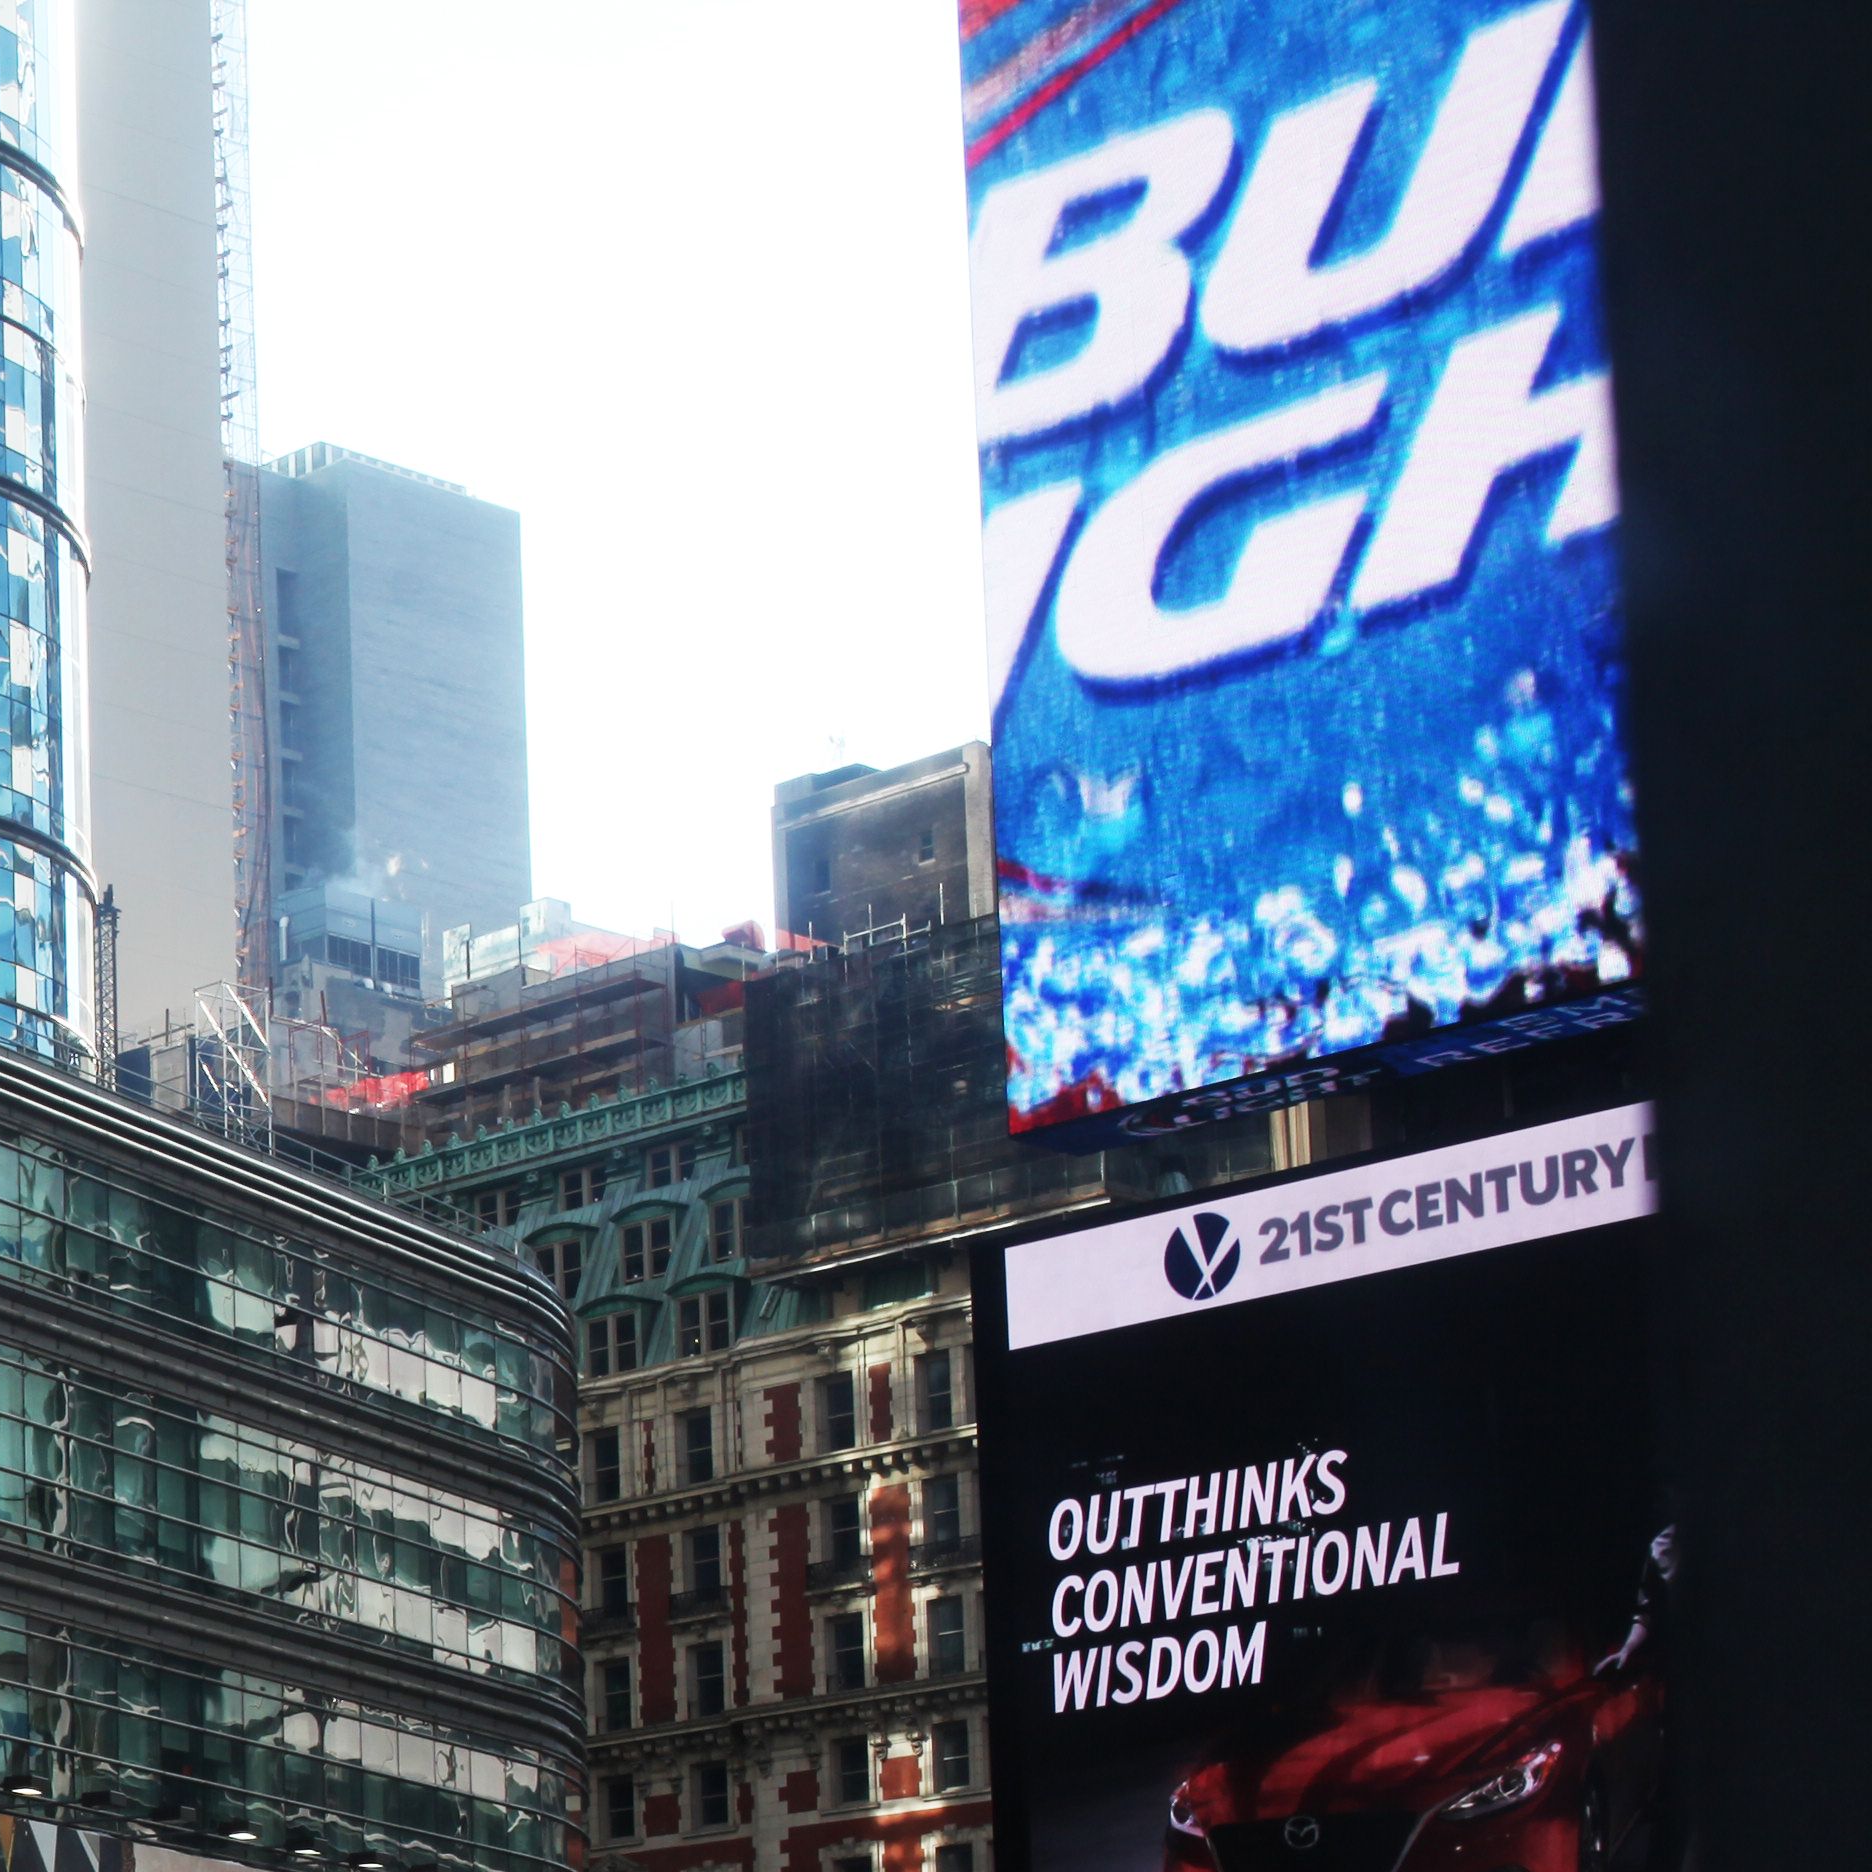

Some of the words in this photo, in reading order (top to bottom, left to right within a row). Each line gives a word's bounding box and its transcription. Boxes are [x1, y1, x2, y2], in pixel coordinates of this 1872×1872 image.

[1258, 1197, 1375, 1265] 21ST
[1378, 1136, 1635, 1237] CENTURY
[1049, 1450, 1348, 1561] OUTTHINKS
[1052, 1513, 1461, 1639] CONVENTIONAL
[1053, 1622, 1268, 1714] WISDOM
